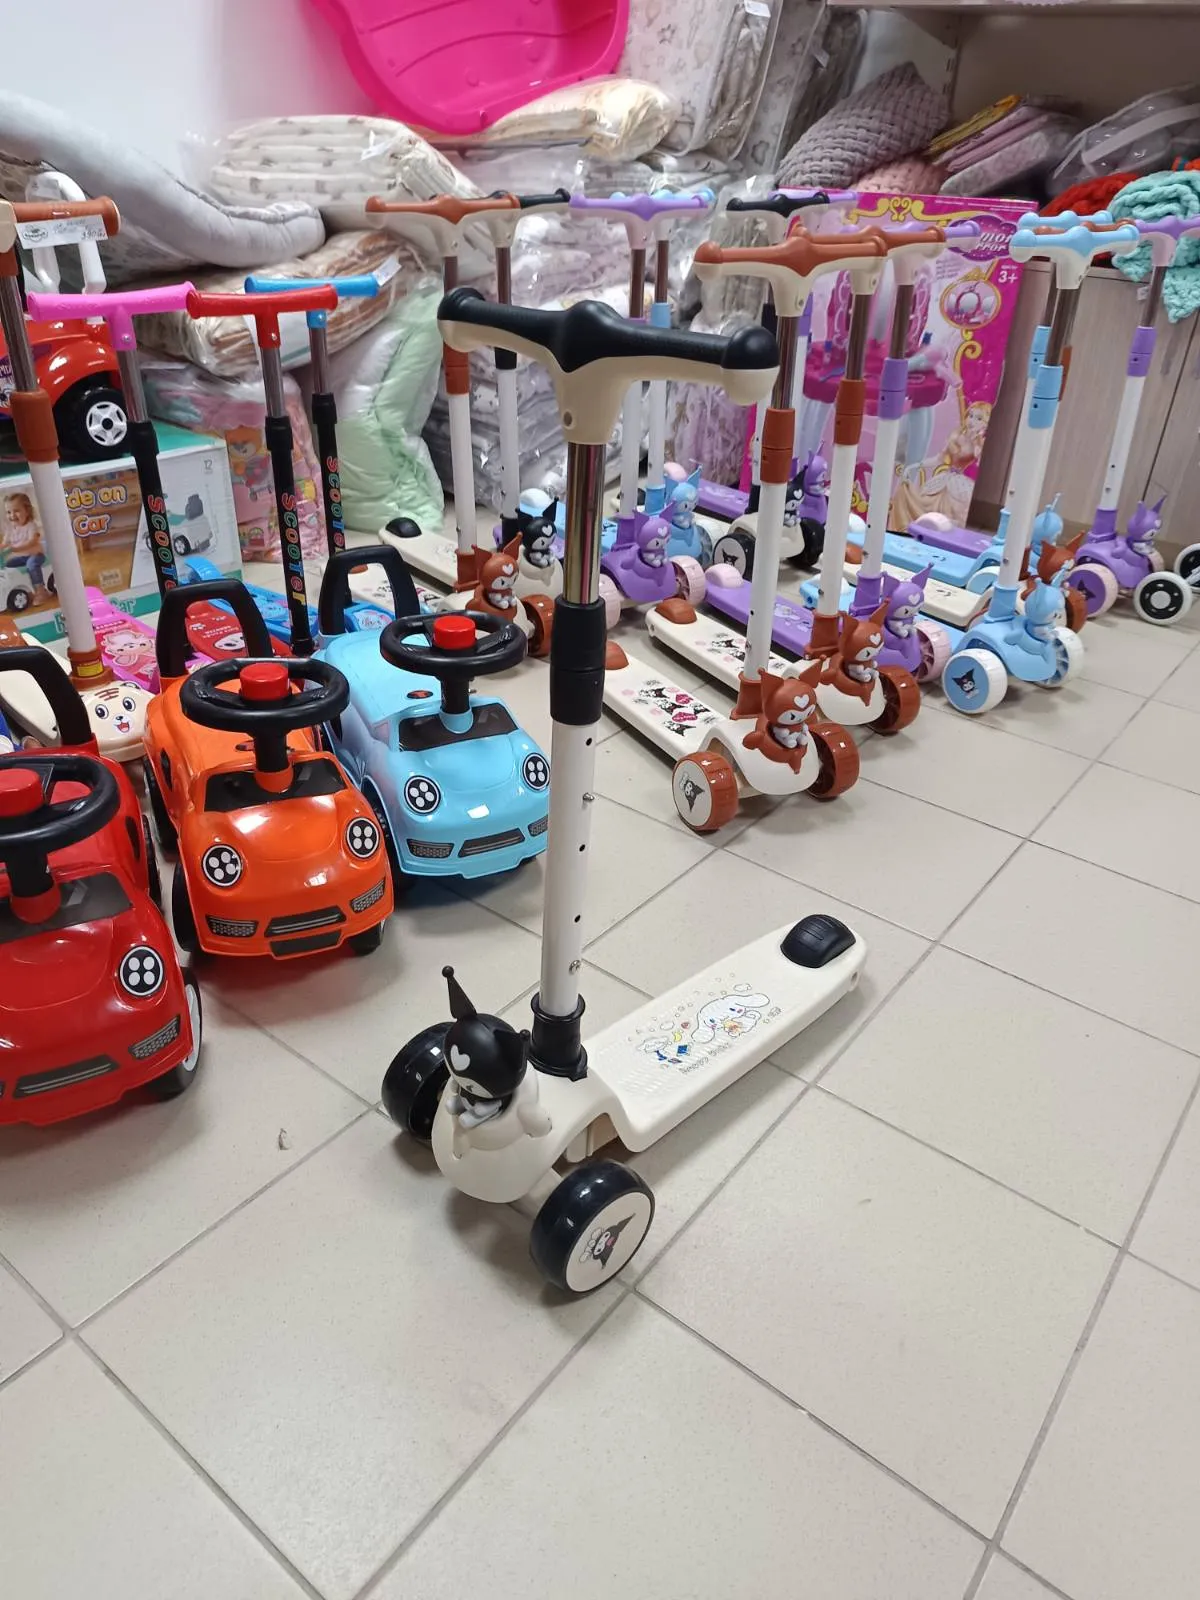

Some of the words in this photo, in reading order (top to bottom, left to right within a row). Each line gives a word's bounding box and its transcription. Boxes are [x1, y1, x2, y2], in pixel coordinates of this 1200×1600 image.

[998, 271, 1018, 283] 3+
[66, 487, 95, 511] de
[99, 484, 127, 505] on
[73, 514, 110, 537] Car
